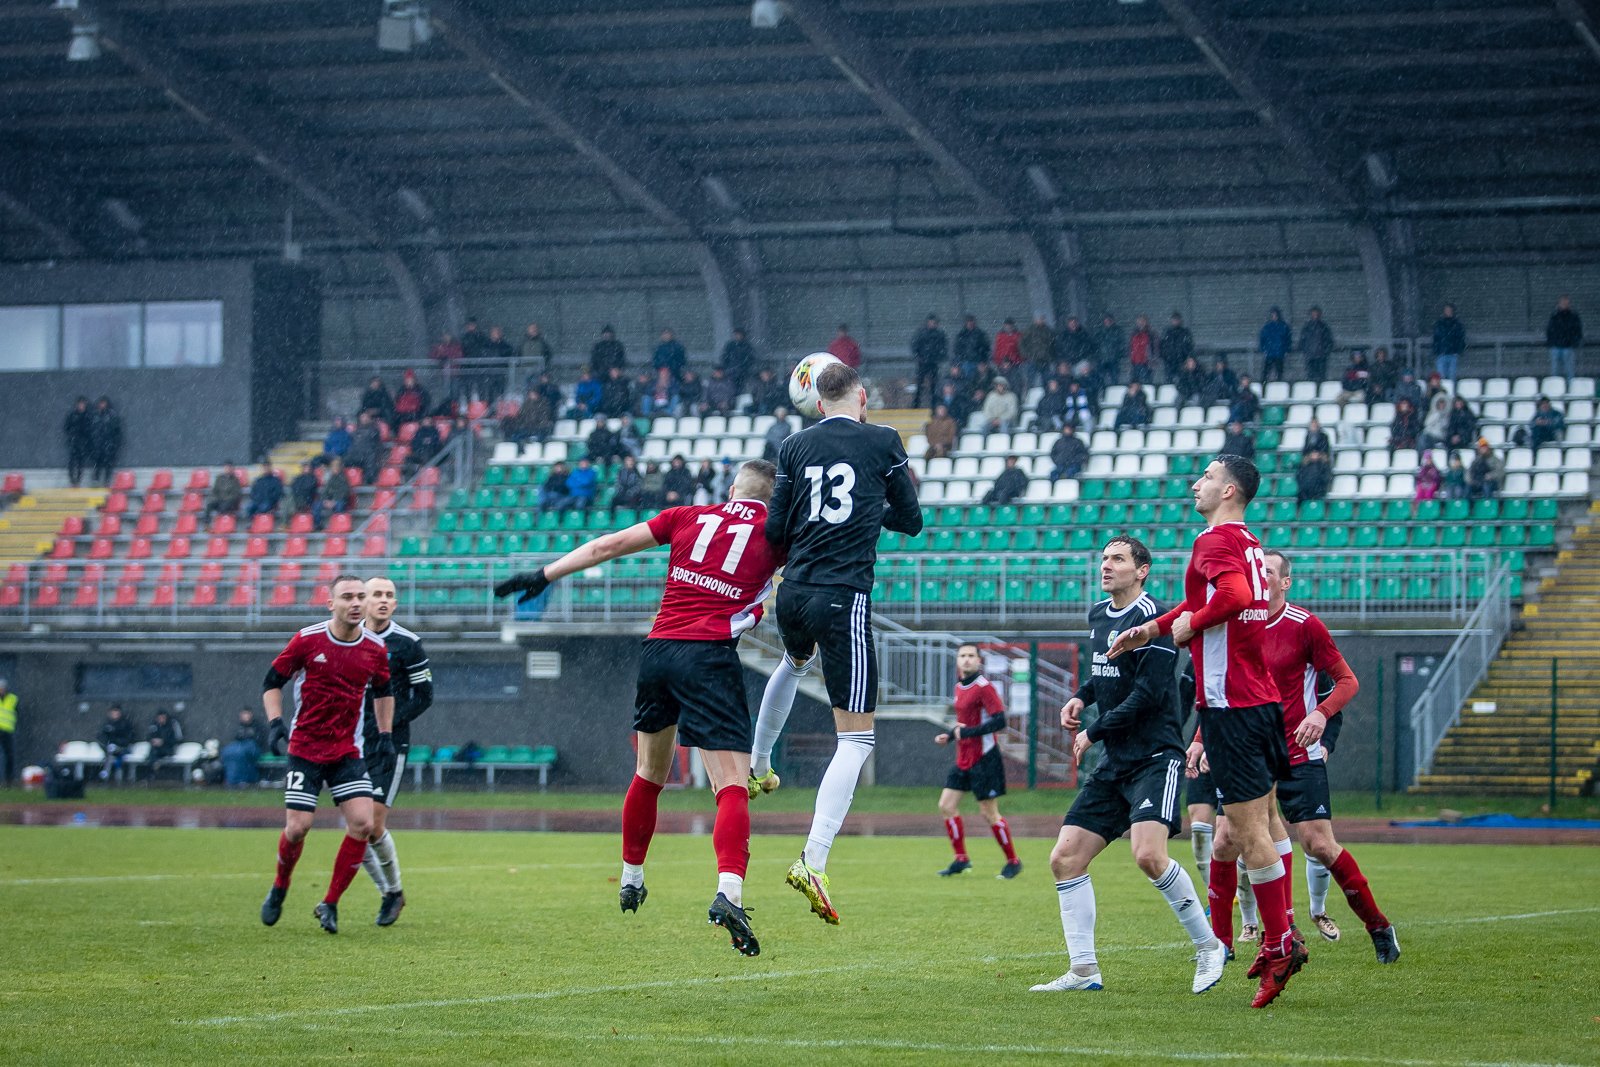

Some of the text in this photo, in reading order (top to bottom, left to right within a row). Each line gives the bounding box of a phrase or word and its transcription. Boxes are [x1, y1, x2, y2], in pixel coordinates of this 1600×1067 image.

[805, 462, 856, 524] 13
[721, 502, 757, 521] APIS
[690, 513, 755, 575] 11
[670, 565, 743, 600] JĘDRZYCHOWICE
[1101, 663, 1121, 678] GÓRA
[286, 770, 305, 790] 12
